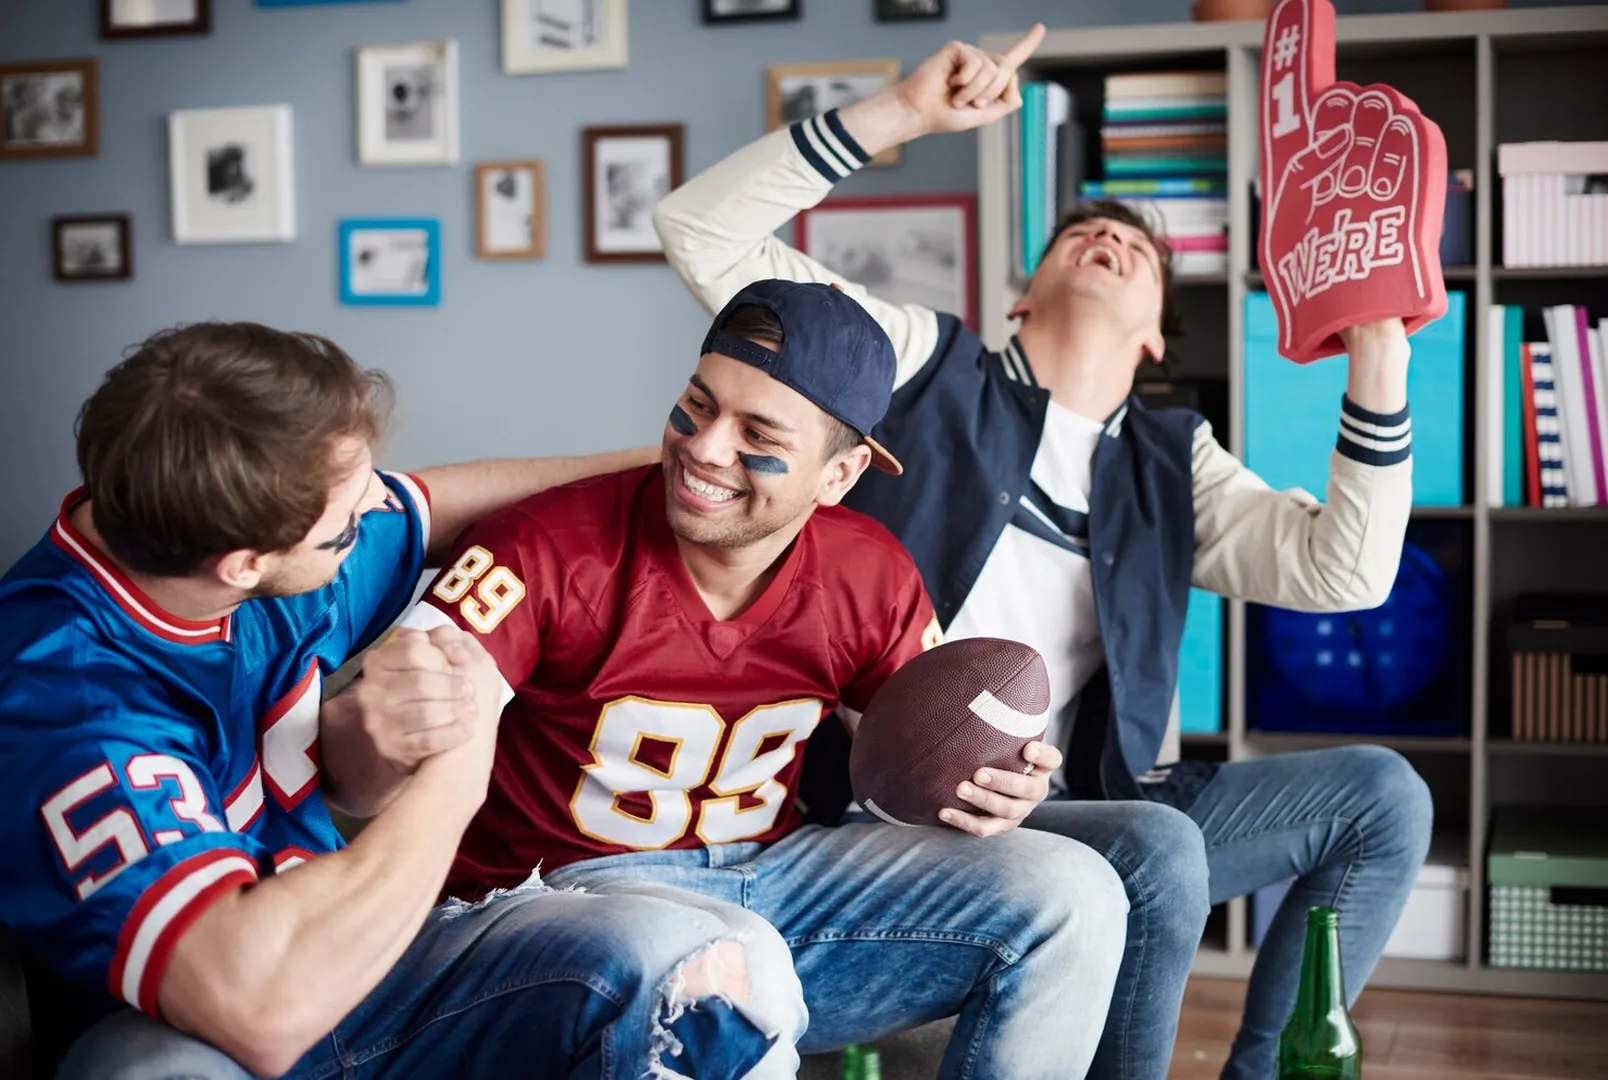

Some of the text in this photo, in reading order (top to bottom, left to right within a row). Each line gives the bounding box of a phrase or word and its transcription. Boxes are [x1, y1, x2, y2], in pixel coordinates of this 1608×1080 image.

[432, 544, 526, 634] 89
[40, 751, 228, 903] 53
[570, 695, 823, 850] 89
